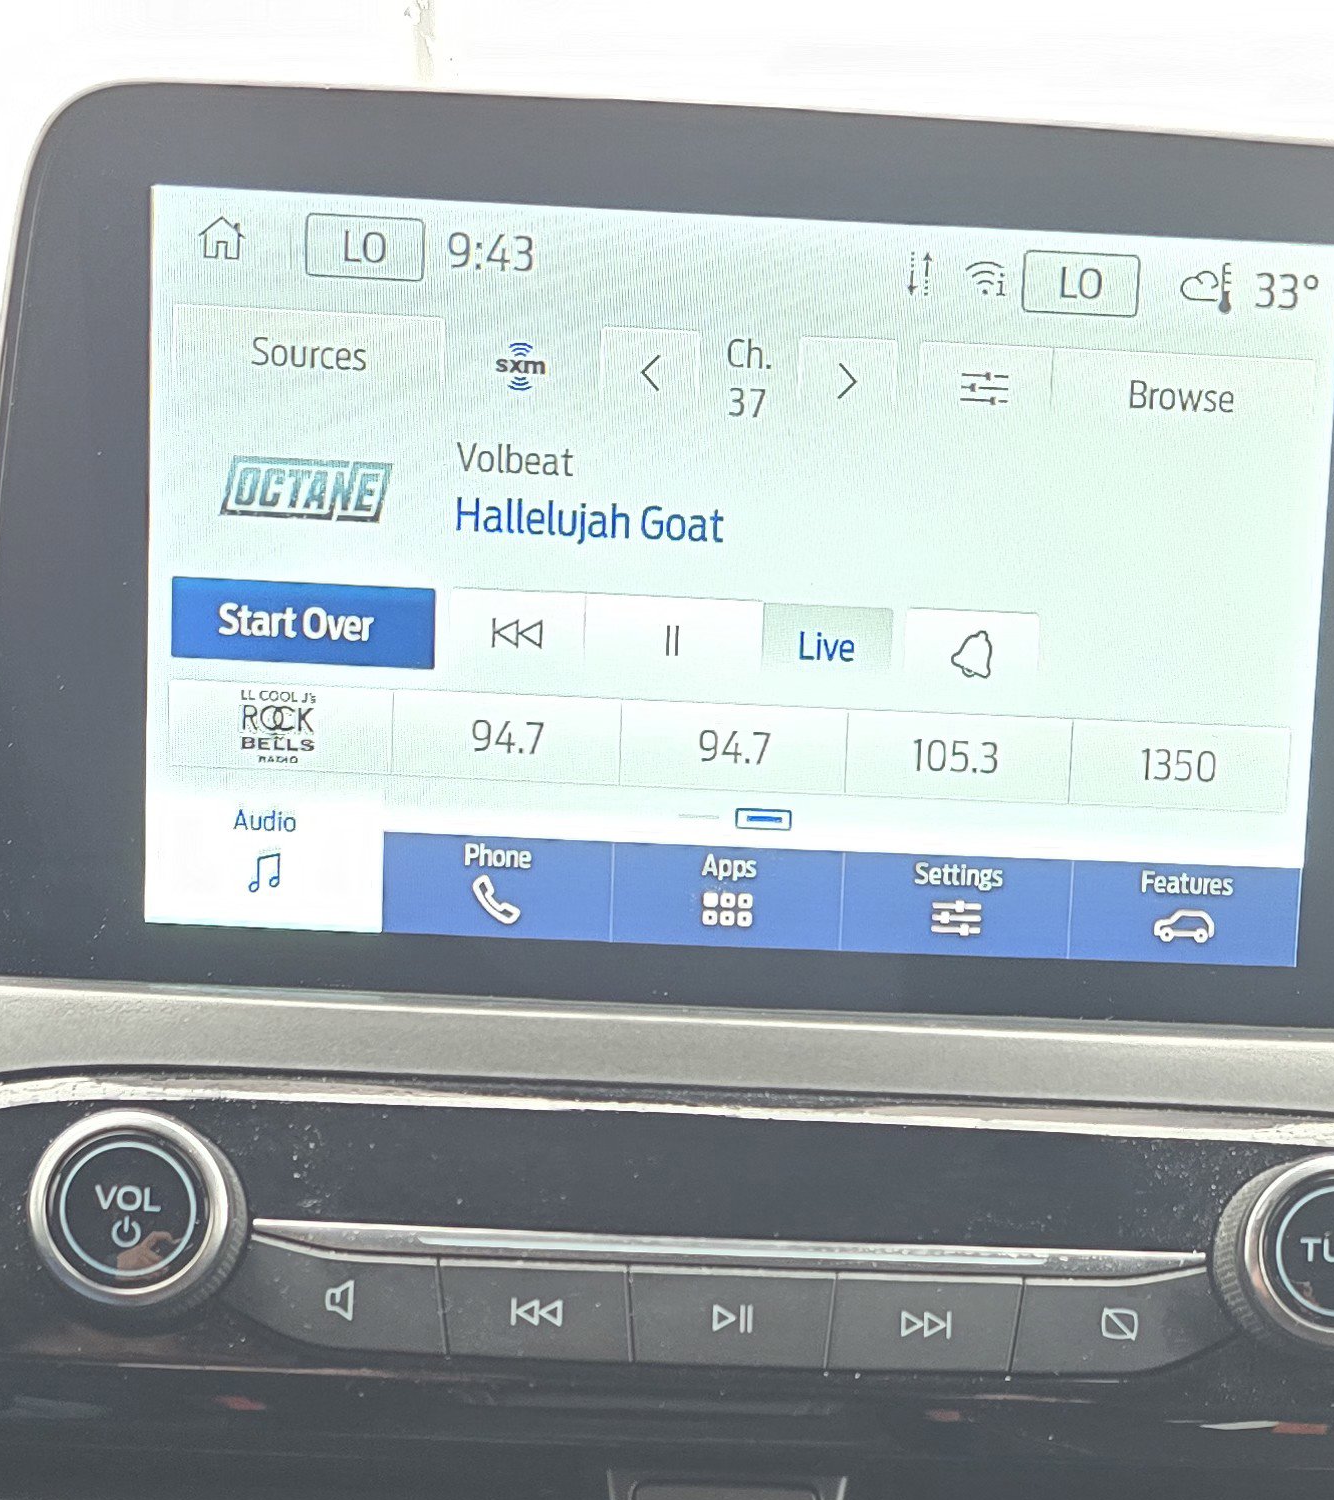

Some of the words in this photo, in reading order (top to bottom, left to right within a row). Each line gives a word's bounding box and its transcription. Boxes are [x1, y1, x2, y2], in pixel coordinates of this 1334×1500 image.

[343, 230, 387, 264] LO
[448, 231, 535, 272] 9:43
[1060, 267, 1103, 301] LO
[250, 336, 368, 373] Sources
[496, 358, 547, 376] sxm
[727, 338, 773, 371] Ch.
[728, 388, 767, 419] 37
[1129, 380, 1235, 414] Browse
[457, 442, 574, 478] Volbeat
[233, 466, 385, 514] OCTANE
[457, 498, 630, 544] Hallelujah
[641, 506, 725, 543] Goat
[218, 603, 297, 638] Start
[303, 607, 375, 642] Over
[799, 631, 855, 663] Live
[241, 690, 255, 700] LL
[259, 690, 298, 702] COOL
[243, 704, 314, 732] ROCK
[241, 736, 315, 751] BELLS
[471, 719, 545, 755] 94.7
[698, 730, 772, 766] 94.7
[913, 738, 999, 774] 105.3
[1141, 747, 1217, 783] 1350
[233, 809, 297, 833] Audio
[464, 842, 532, 870] Phone
[701, 853, 757, 881] Apps
[914, 861, 1004, 891] Settings
[1140, 869, 1234, 897] Features
[95, 1184, 162, 1213] VOL
